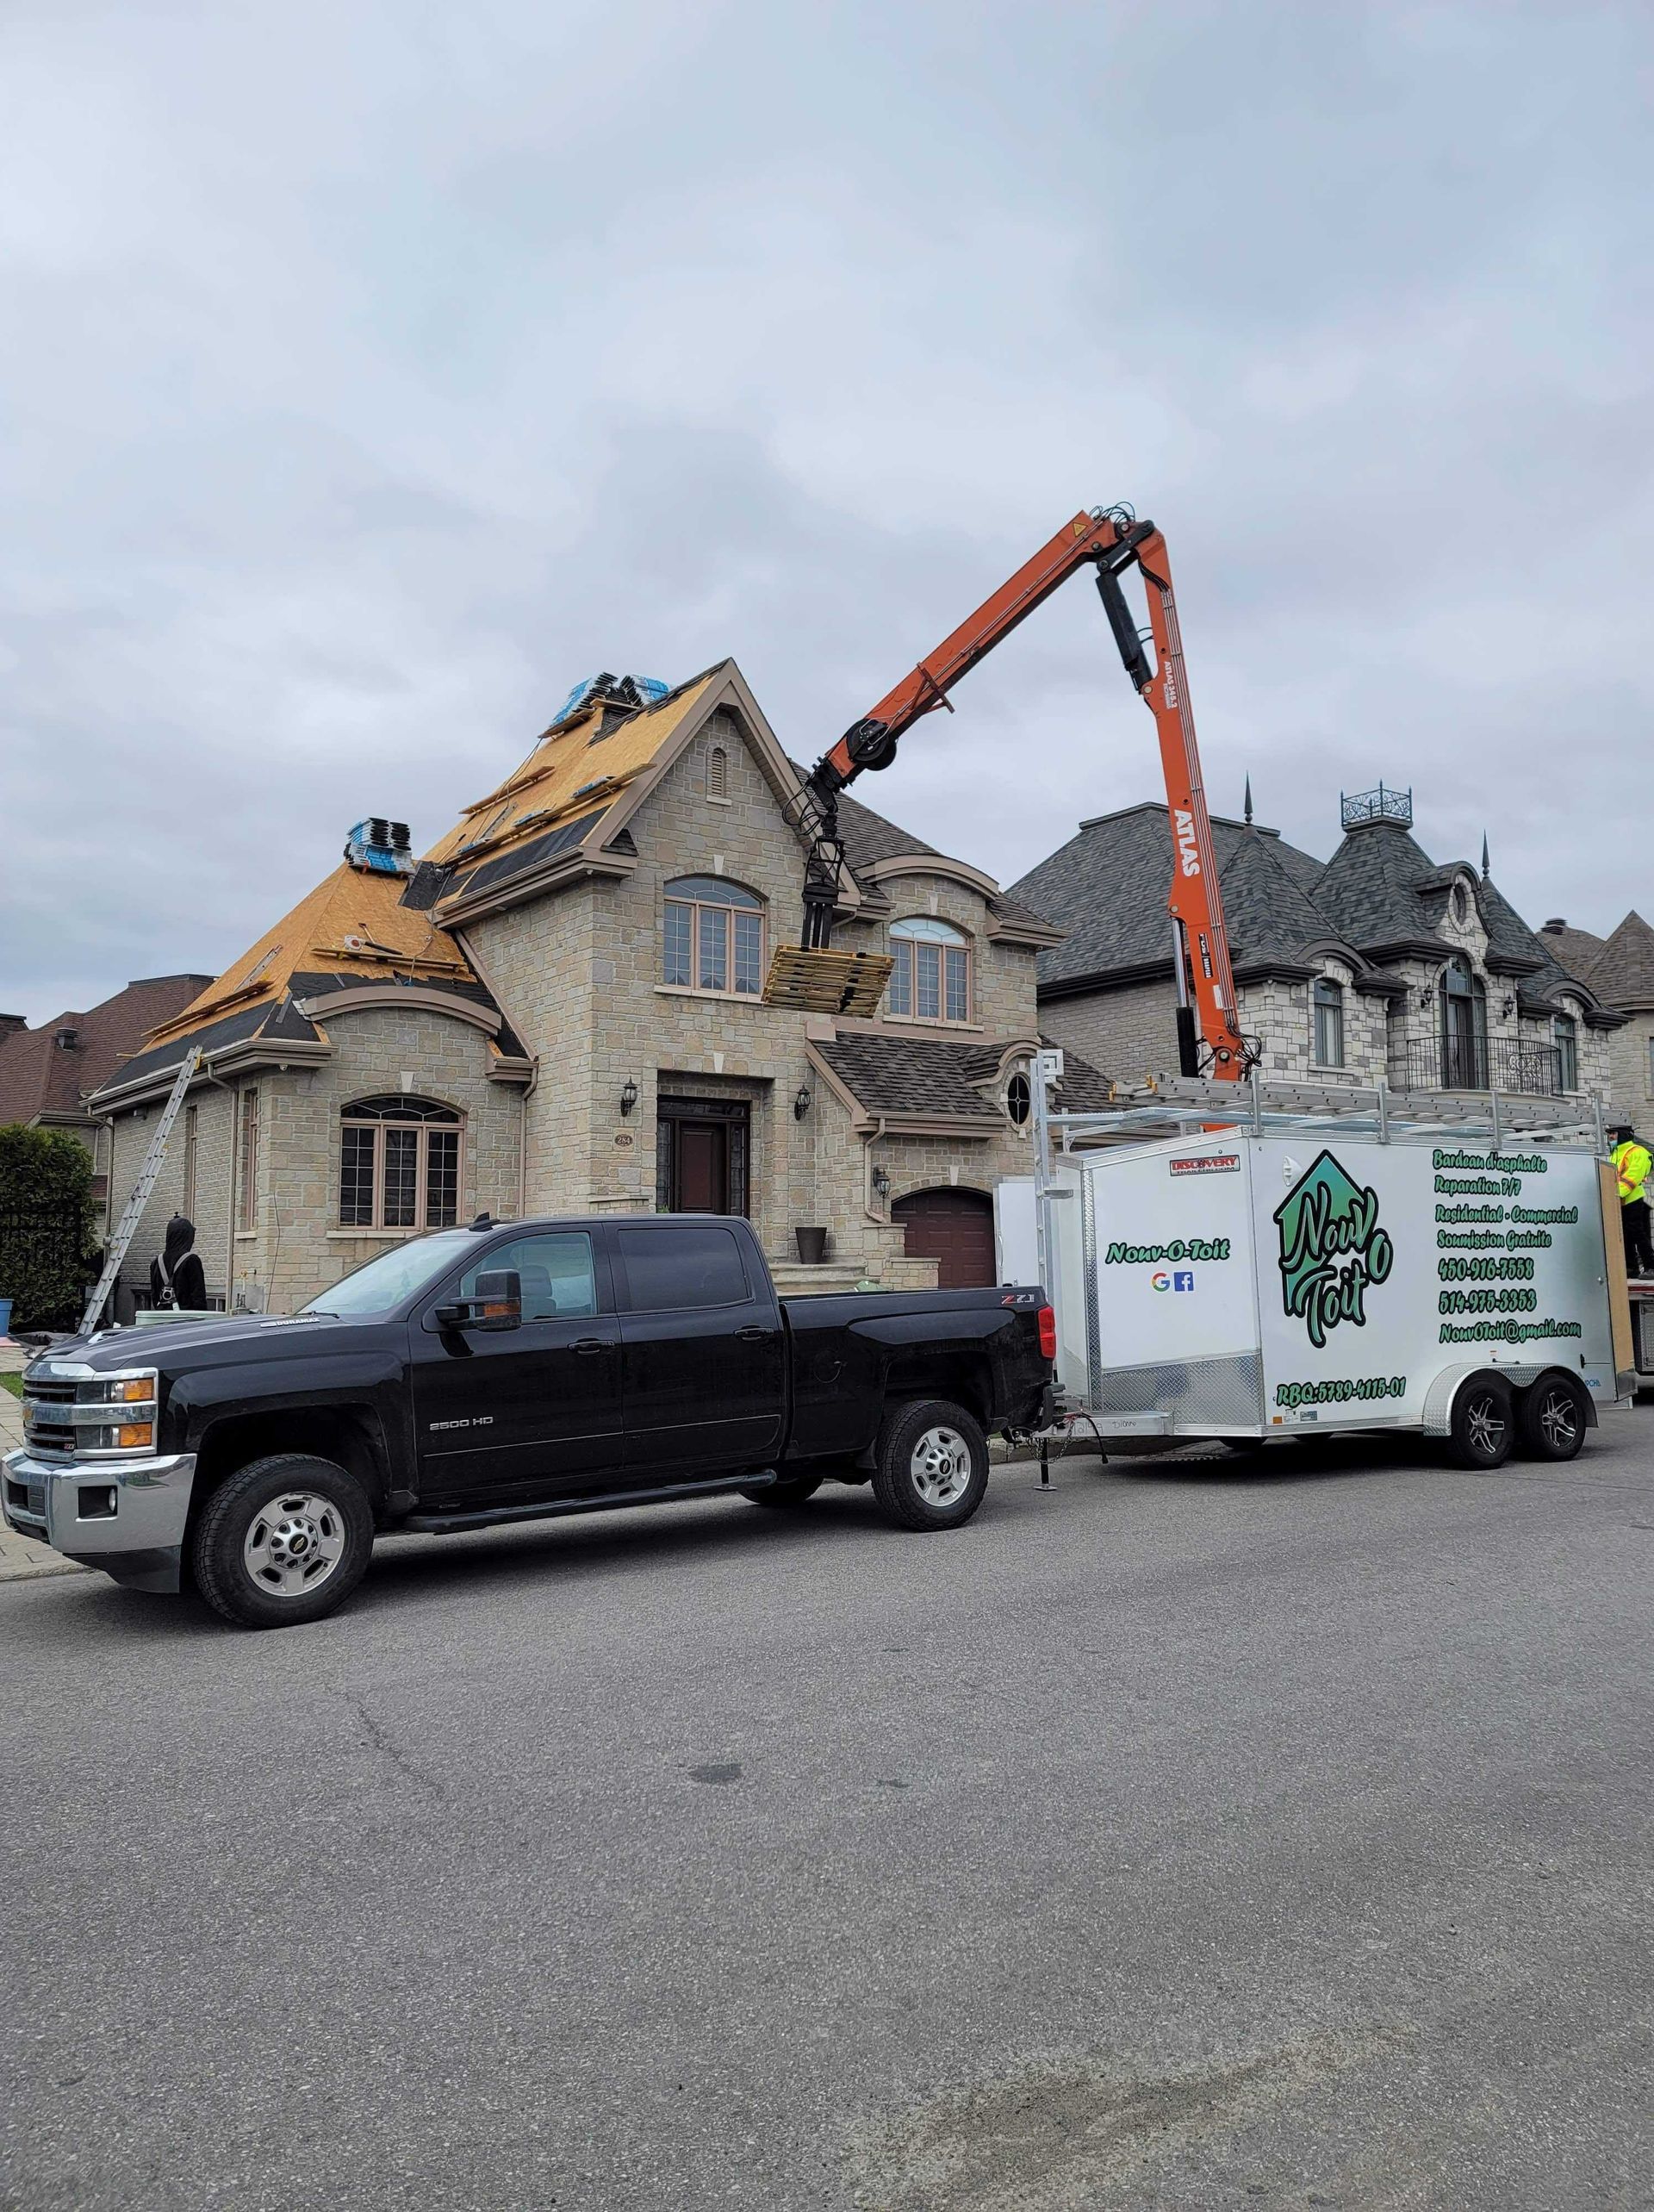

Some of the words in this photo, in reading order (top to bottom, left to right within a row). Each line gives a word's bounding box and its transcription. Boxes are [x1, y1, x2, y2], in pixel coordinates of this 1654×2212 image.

[1164, 661, 1174, 685] ATLAS
[1174, 809, 1200, 877] ATLAS
[618, 1137, 631, 1145] 284
[1172, 1156, 1237, 1170] DISCOVERY
[1433, 1149, 1485, 1169] Bardeau
[1486, 1151, 1547, 1175] d'asphalte
[1434, 1175, 1501, 1197] Reparation
[1502, 1177, 1521, 1197] 7/7
[1435, 1204, 1504, 1224] Residential
[1511, 1205, 1578, 1224] Commercial
[1105, 1238, 1230, 1264] Nouv-O-Toit
[1437, 1230, 1505, 1249] Soumission
[1506, 1230, 1551, 1251] Gratuite
[1438, 1257, 1534, 1281] 450-916-7558
[1001, 1293, 1035, 1305] Z71
[1292, 1257, 1370, 1349] Toit
[1439, 1288, 1537, 1314] 514-975-3353
[277, 1318, 320, 1326] DURAMAX
[430, 1419, 469, 1430] 2500
[472, 1417, 494, 1426] HD
